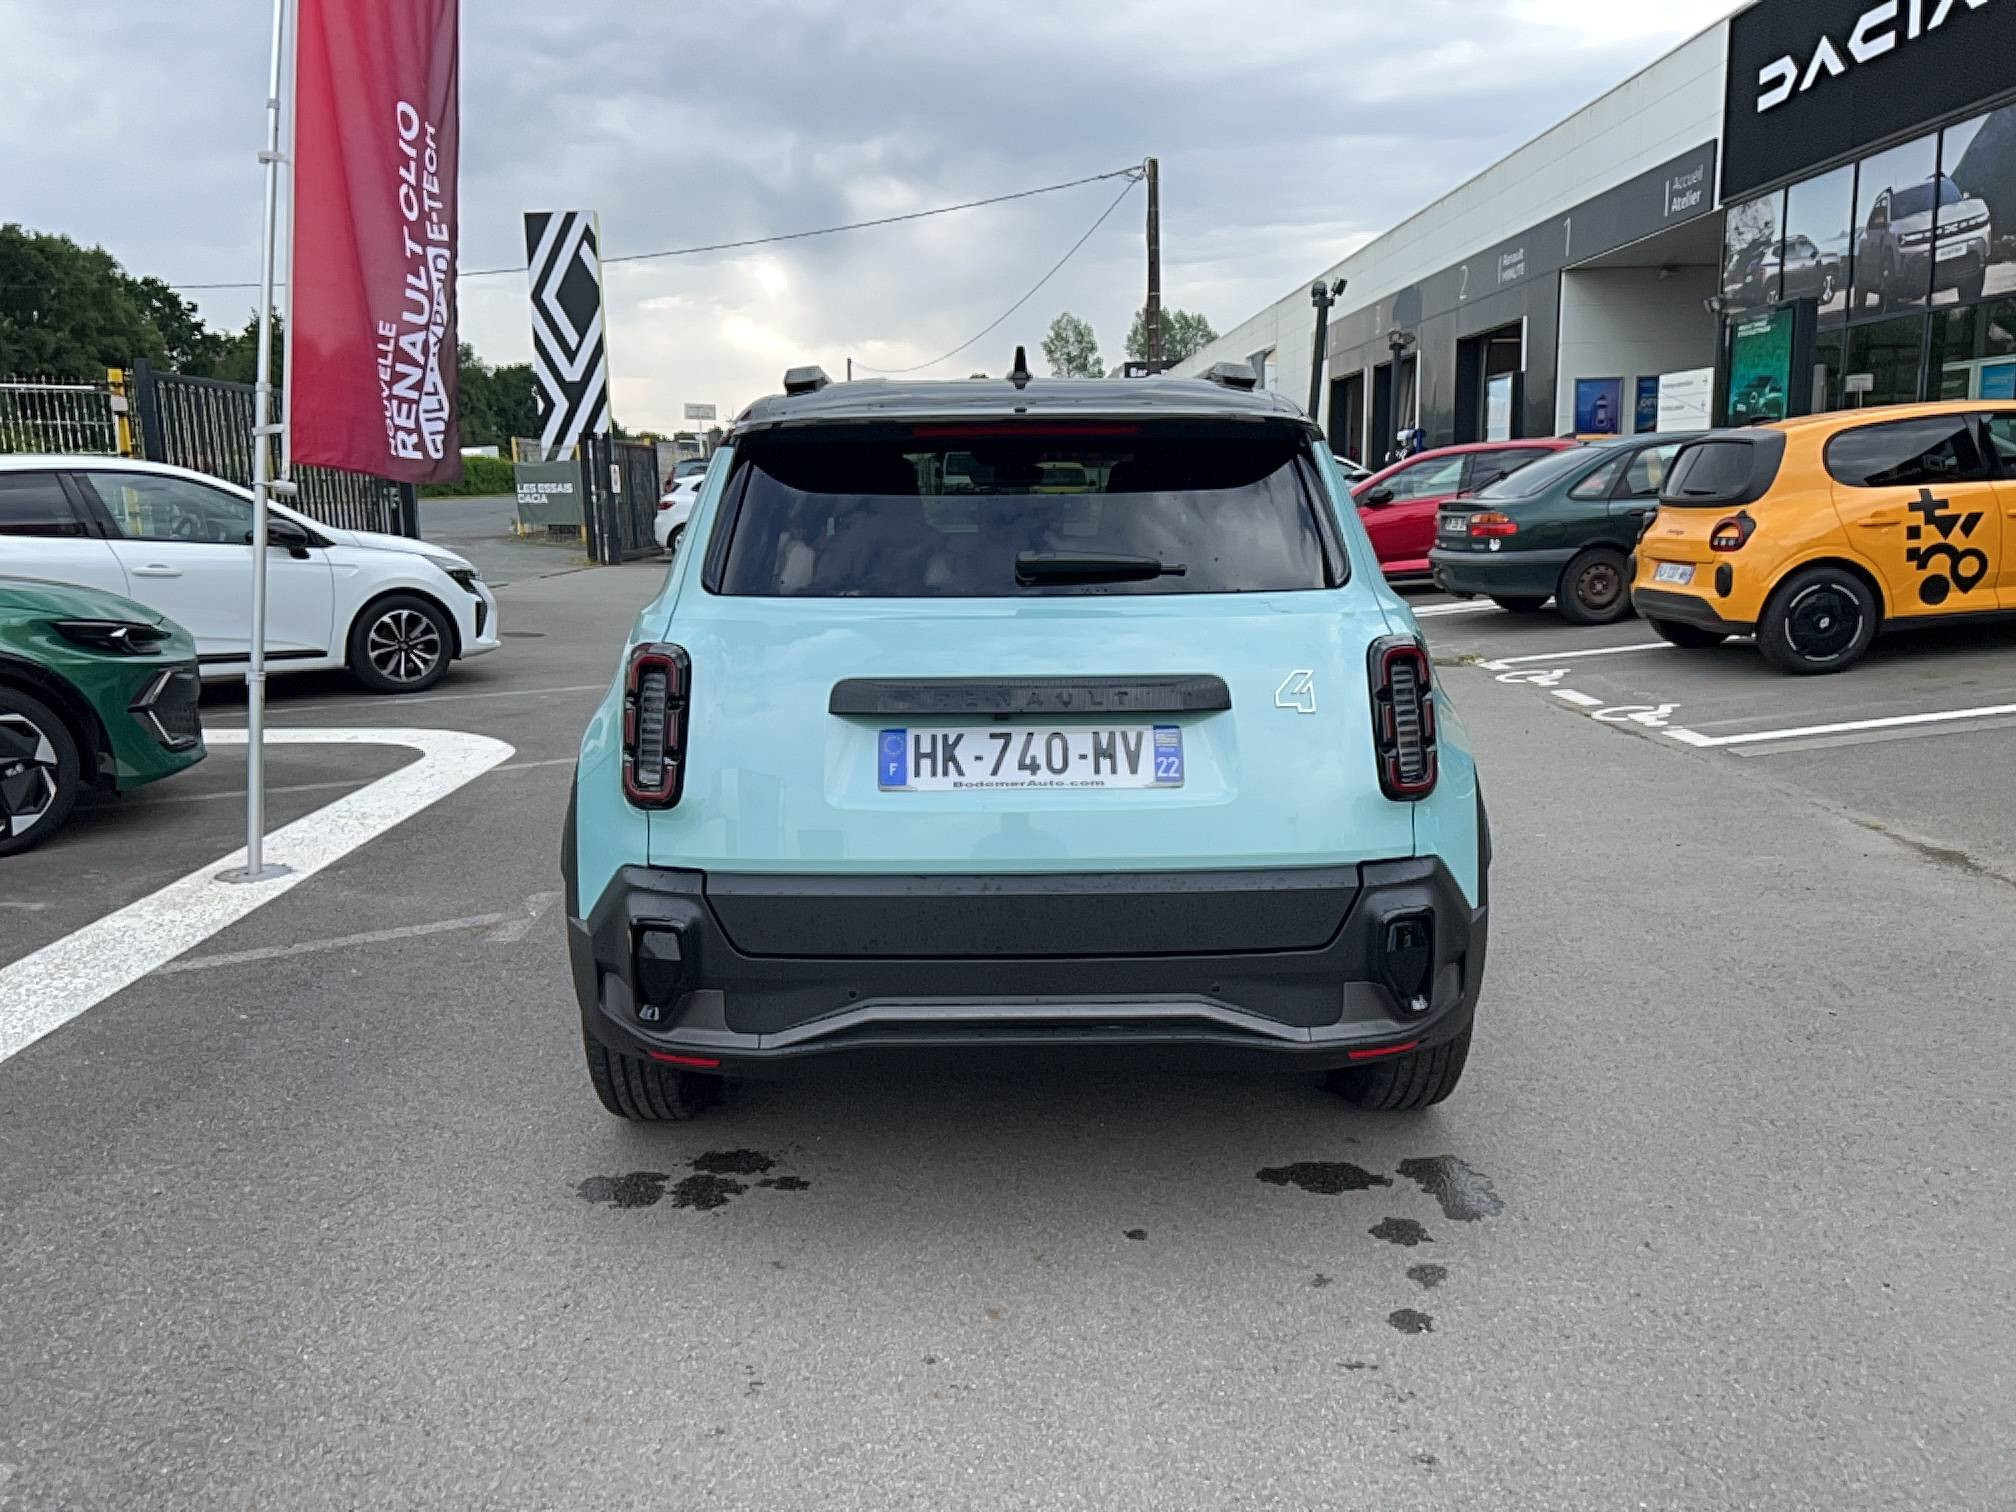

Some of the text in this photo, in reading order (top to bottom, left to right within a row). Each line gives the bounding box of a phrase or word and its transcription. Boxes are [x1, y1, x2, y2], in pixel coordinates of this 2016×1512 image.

[1756, 0, 1988, 113] DACI
[1563, 217, 1571, 257] 1
[391, 101, 430, 459] RENAULT CLIO
[1459, 265, 1469, 300] 2
[888, 762, 898, 777] F
[913, 731, 1144, 778] HK-740-MV
[1157, 756, 1180, 777] 22
